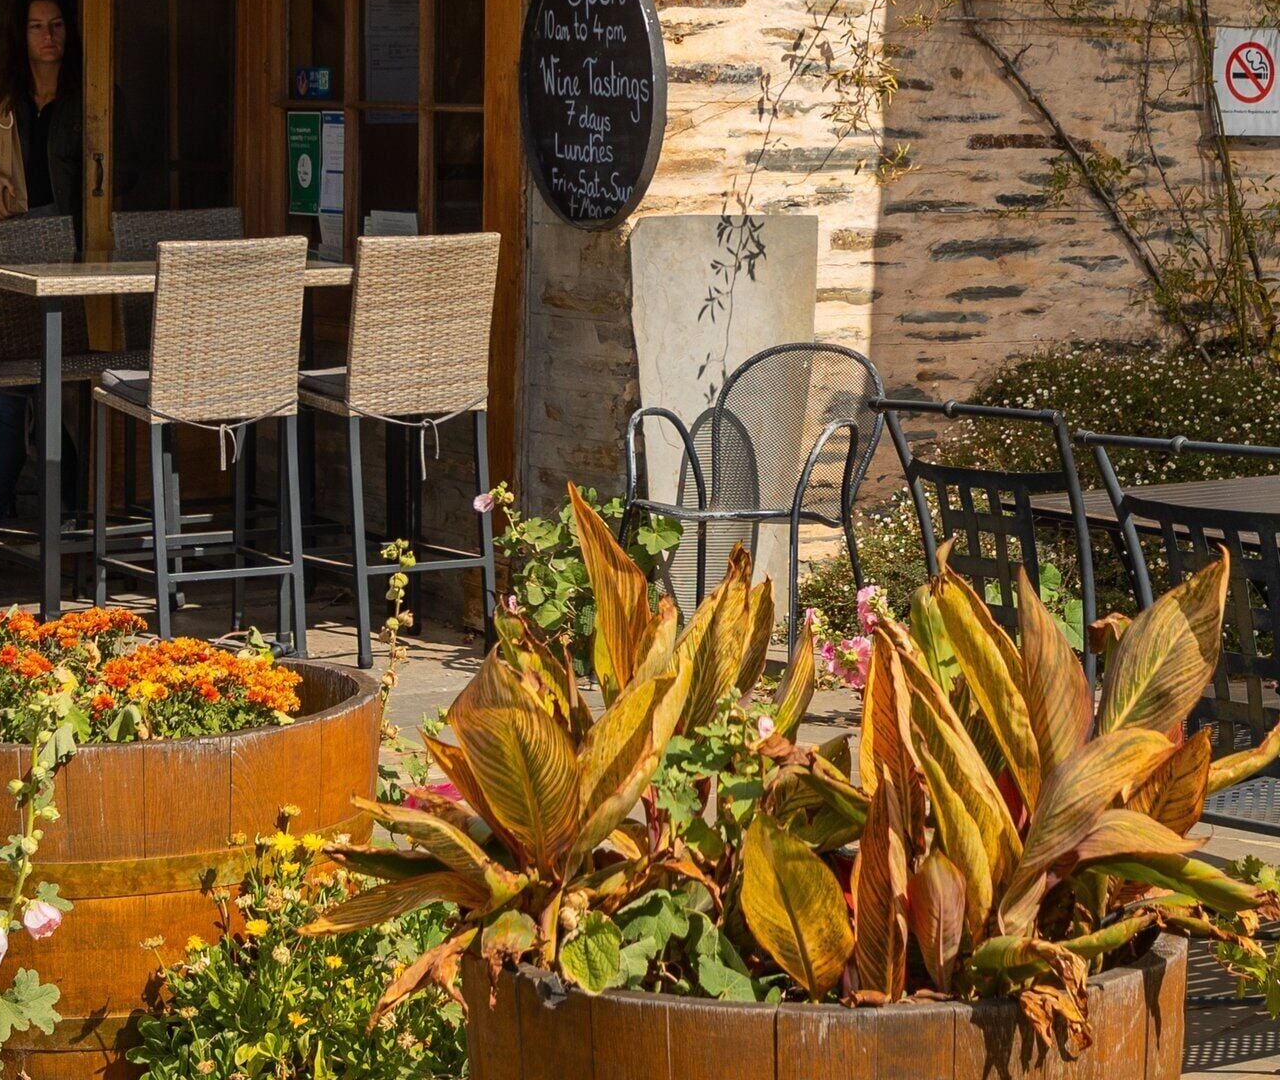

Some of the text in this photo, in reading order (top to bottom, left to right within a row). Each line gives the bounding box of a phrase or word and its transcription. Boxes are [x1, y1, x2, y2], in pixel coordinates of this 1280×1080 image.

[574, 15, 587, 42] to
[540, 54, 650, 123] Wine Tastings
[565, 100, 611, 142] 7 days
[555, 132, 614, 164] Lunches
